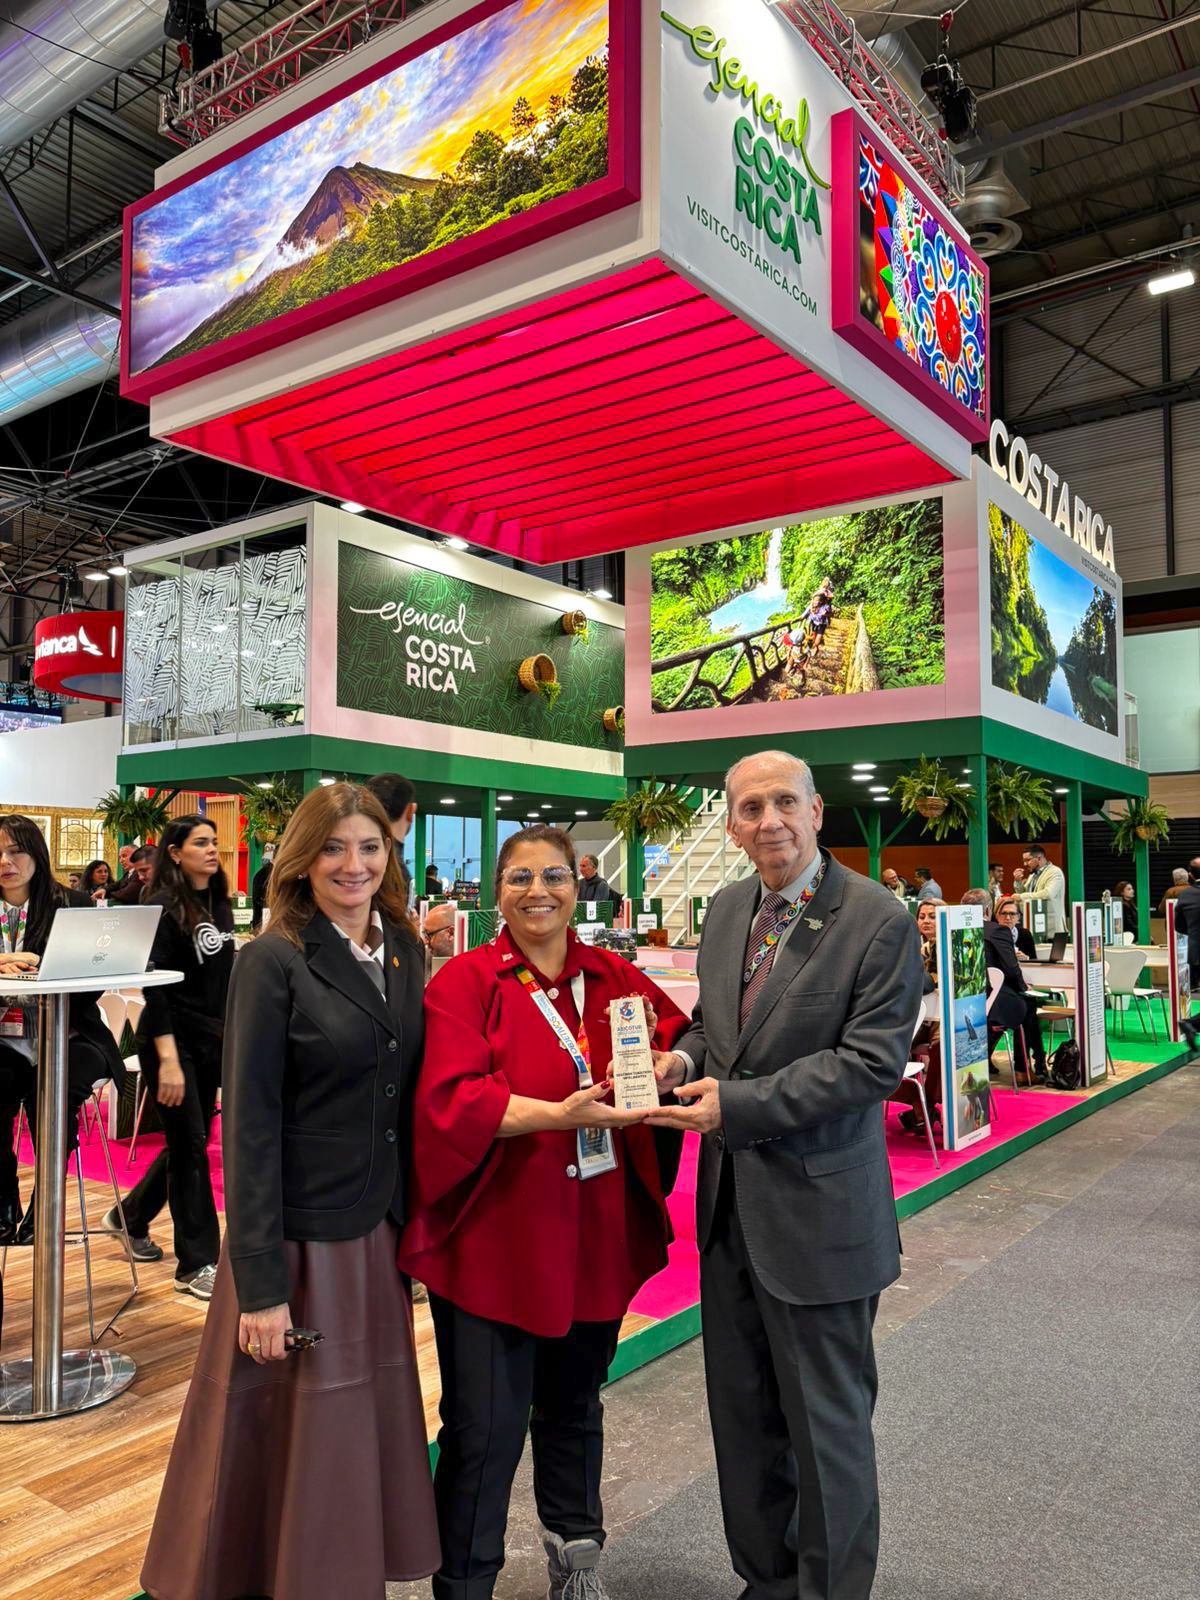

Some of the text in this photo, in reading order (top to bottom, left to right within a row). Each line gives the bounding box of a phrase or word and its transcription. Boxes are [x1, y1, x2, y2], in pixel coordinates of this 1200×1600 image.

[734, 116, 822, 236] COSTA
[735, 165, 802, 265] RICA
[687, 195, 818, 316] VISITCOSTARICA.COM
[989, 418, 1116, 574] COSTA RICA
[405, 635, 476, 673] COSTA
[406, 662, 459, 695] RICA
